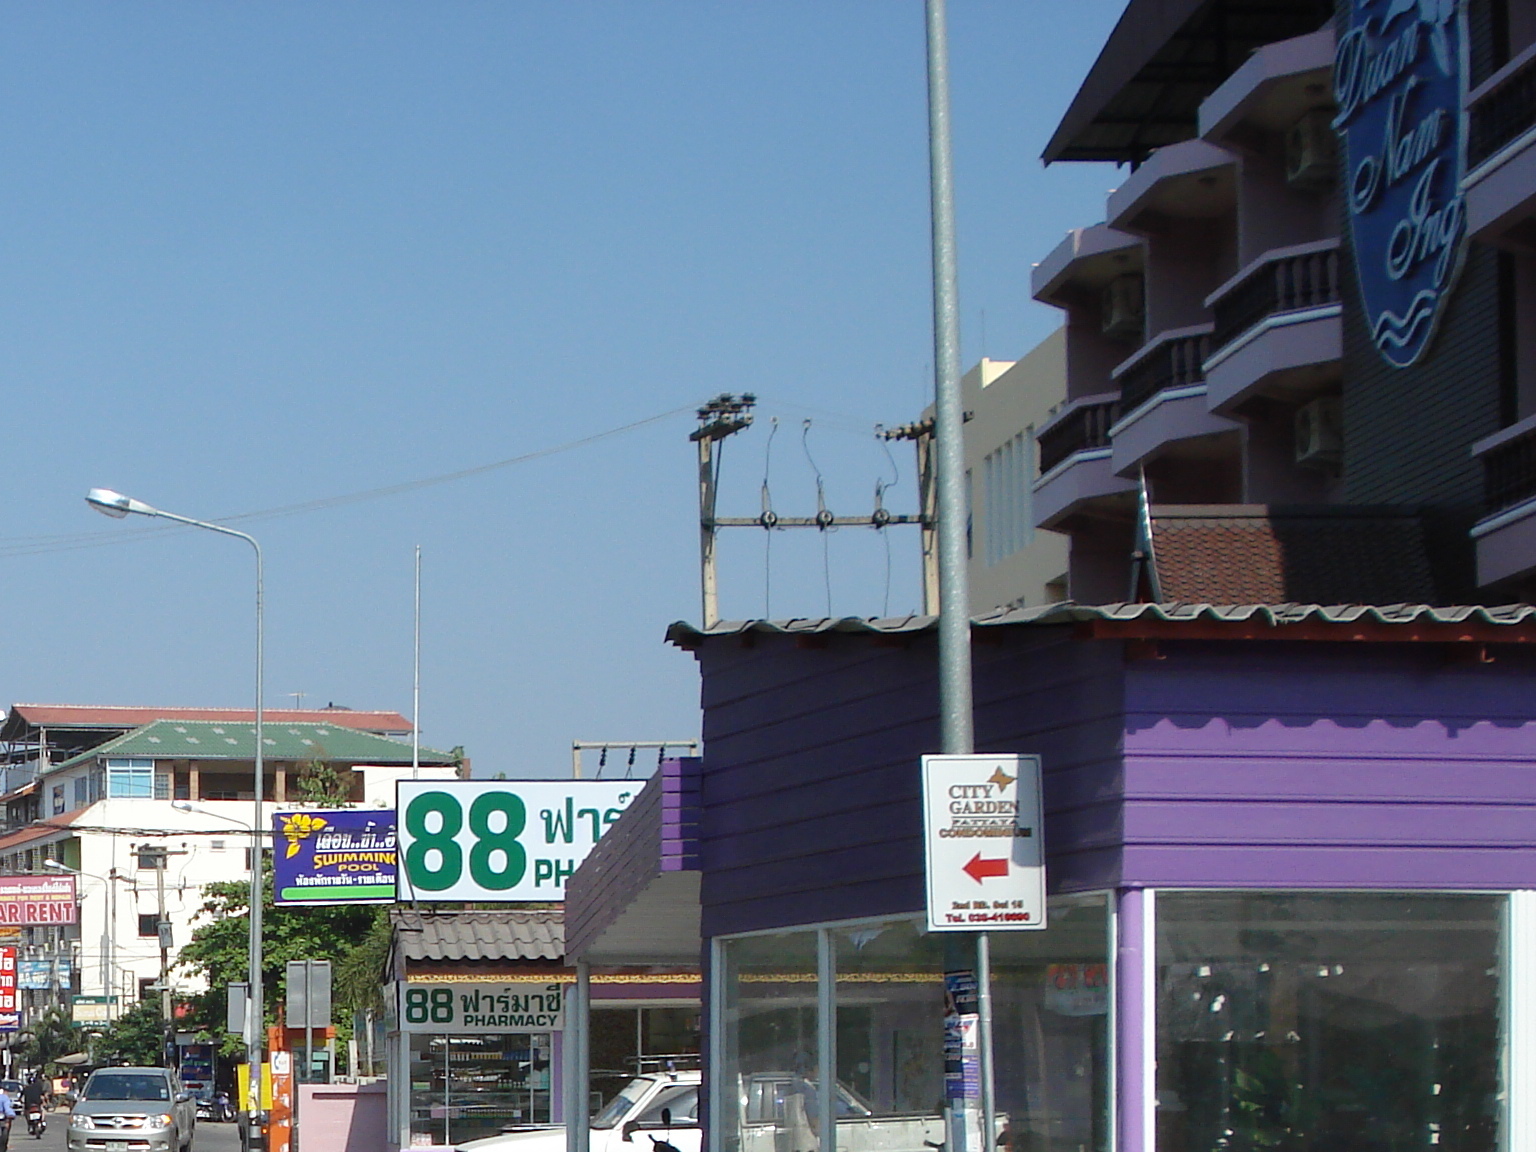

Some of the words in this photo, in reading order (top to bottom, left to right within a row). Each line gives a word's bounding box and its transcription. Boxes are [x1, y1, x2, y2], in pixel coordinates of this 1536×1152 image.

[948, 785, 994, 799] CITY
[949, 800, 1020, 814] GARDEN
[952, 818, 1019, 826] PATTAYA
[939, 827, 1032, 838] CONDOMINIUM
[405, 791, 527, 891] 88
[338, 863, 380, 872] POOL
[25, 902, 73, 924] RENT
[405, 988, 454, 1024] 88
[464, 1014, 559, 1027] PHARMACY
